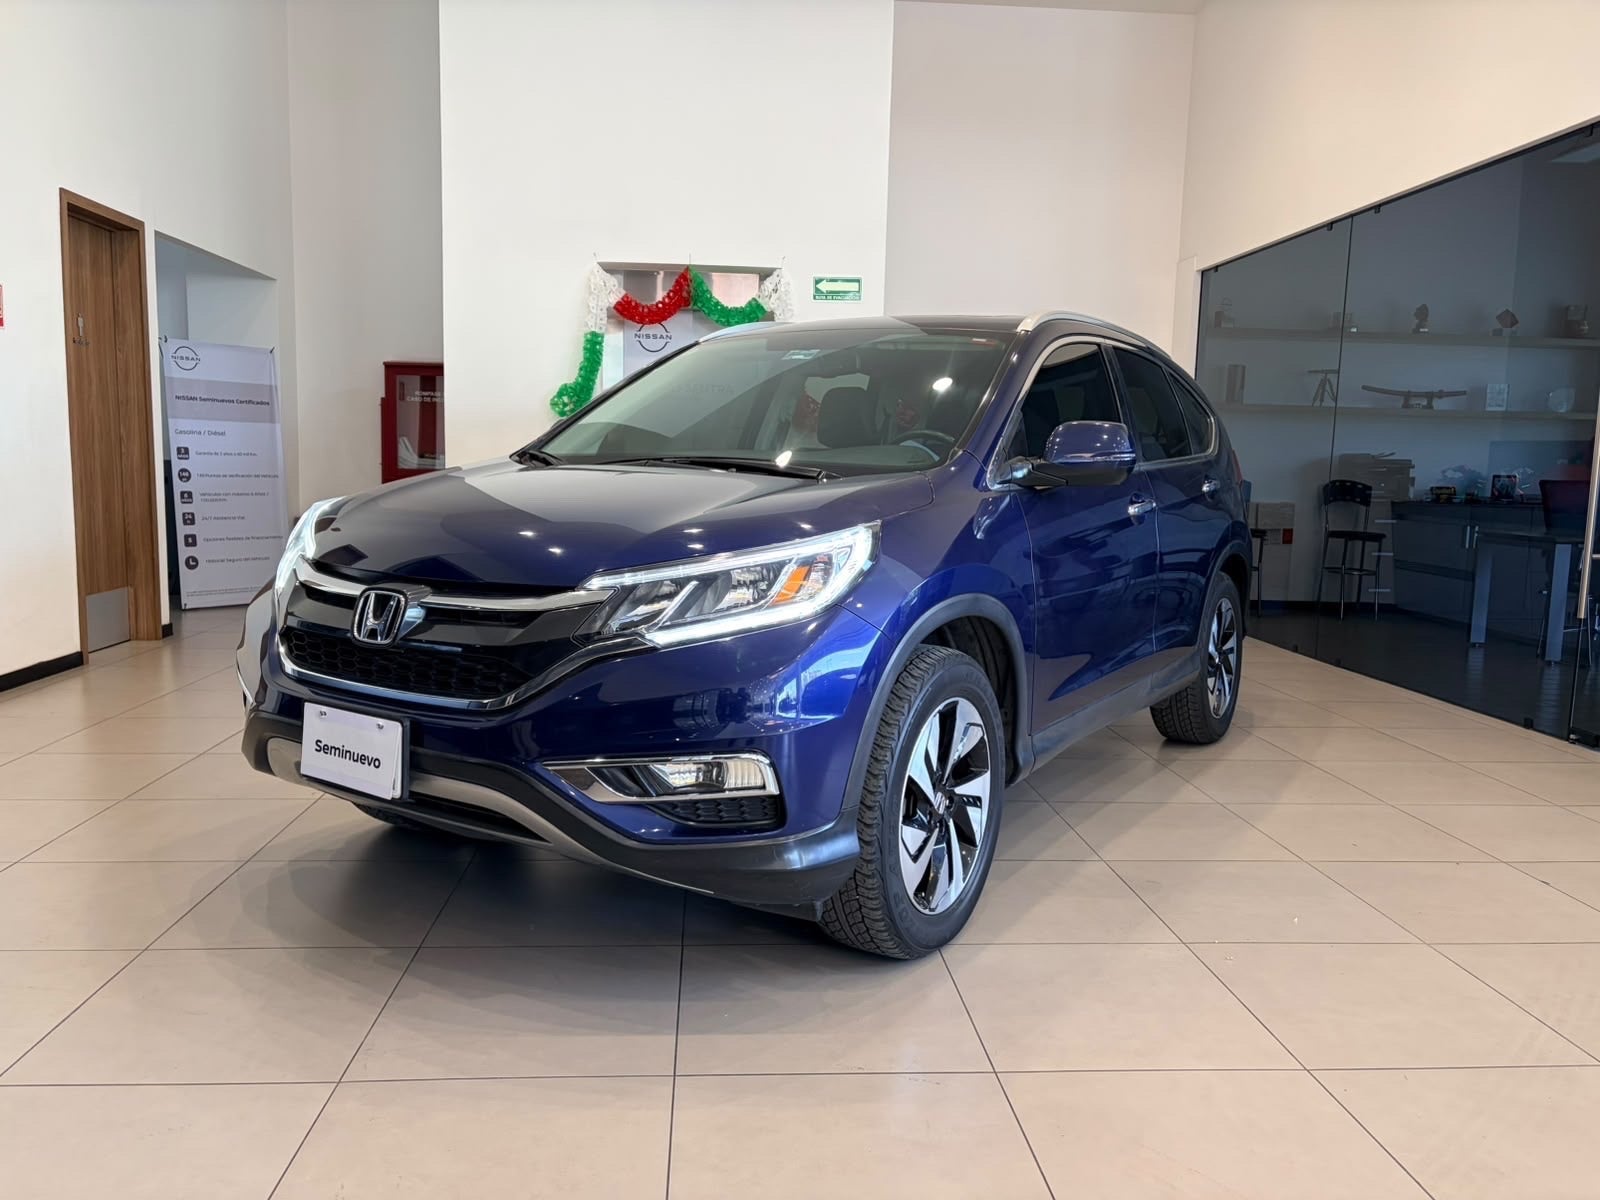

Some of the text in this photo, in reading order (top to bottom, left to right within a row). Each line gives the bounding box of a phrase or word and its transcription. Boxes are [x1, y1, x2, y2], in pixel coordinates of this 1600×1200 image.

[199, 396, 235, 404] Seminuevos
[236, 398, 270, 406] Certificados
[315, 739, 381, 769] Seminuevo
